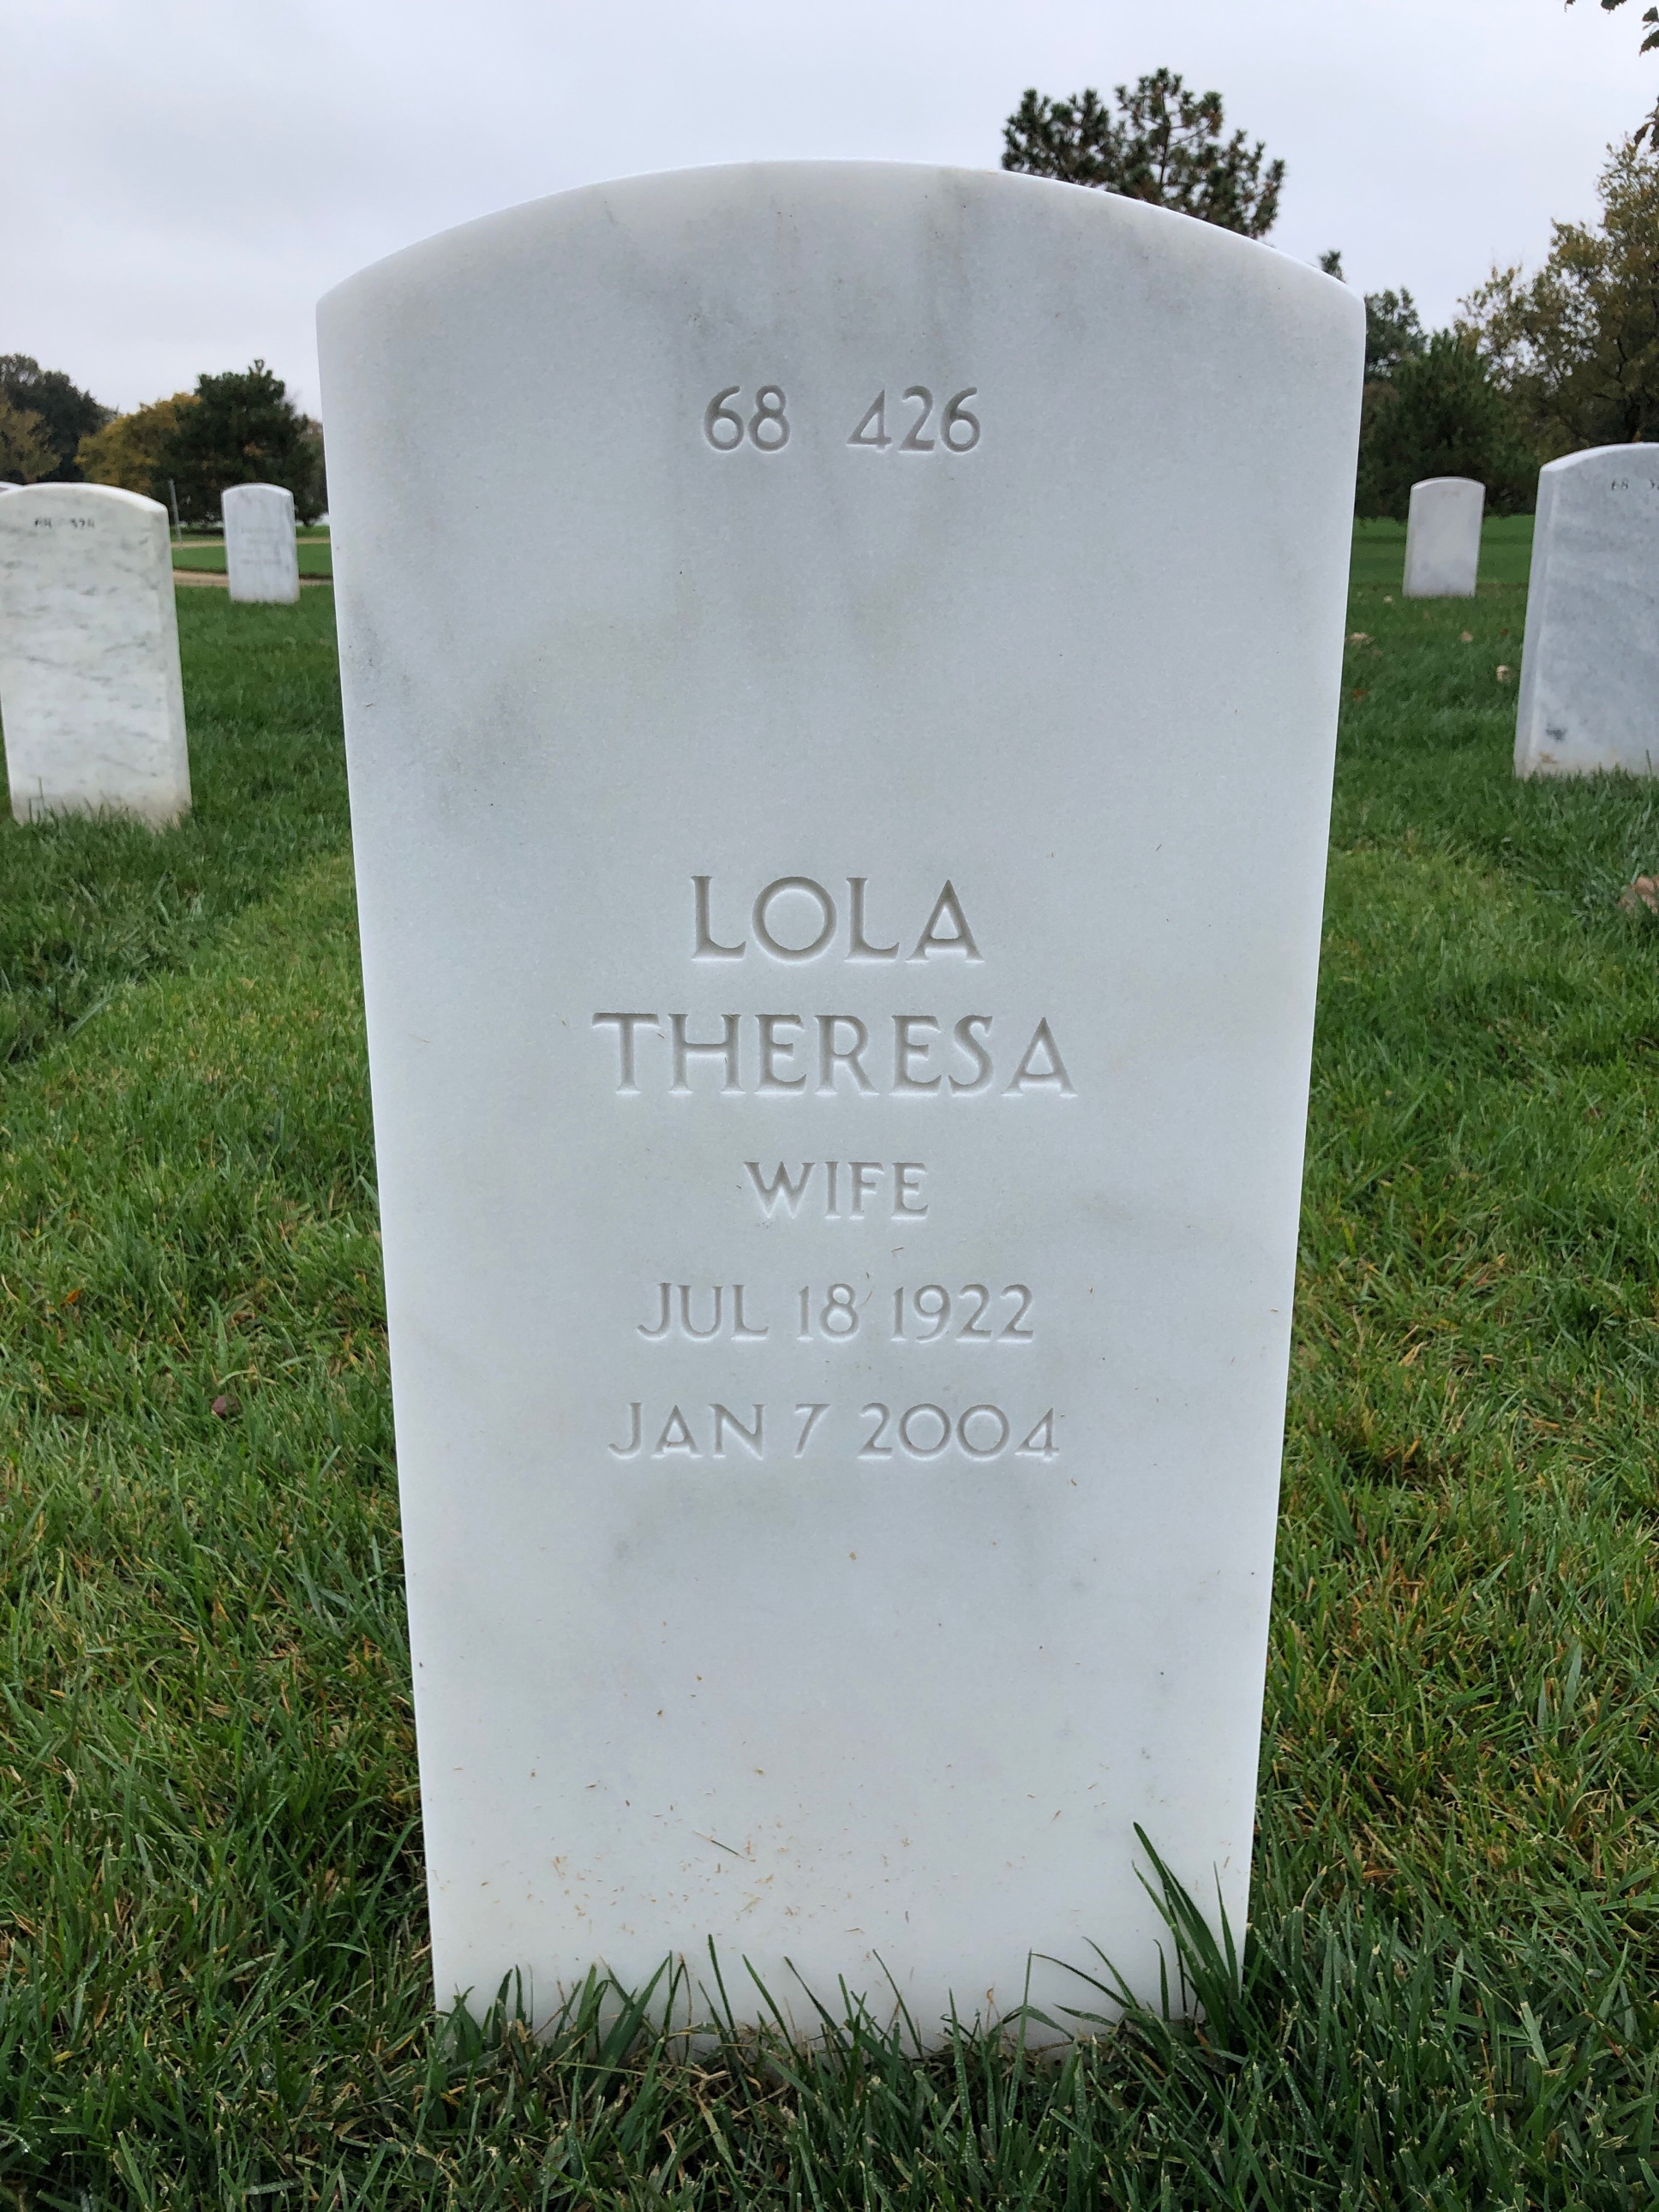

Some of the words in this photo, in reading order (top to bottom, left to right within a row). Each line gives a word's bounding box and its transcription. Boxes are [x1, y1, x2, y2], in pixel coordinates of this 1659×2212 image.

[704, 385, 790, 453] 68
[847, 386, 982, 453] 426
[691, 876, 983, 963] LOLA
[592, 1012, 1075, 1100] THERESA
[743, 1160, 929, 1220] WIFE
[636, 1283, 770, 1341] JUL
[796, 1283, 860, 1343] 18
[891, 1284, 1034, 1343] 1922
[608, 1402, 766, 1460] JAN
[794, 1402, 831, 1459] 7
[858, 1401, 1060, 1462] 2004
